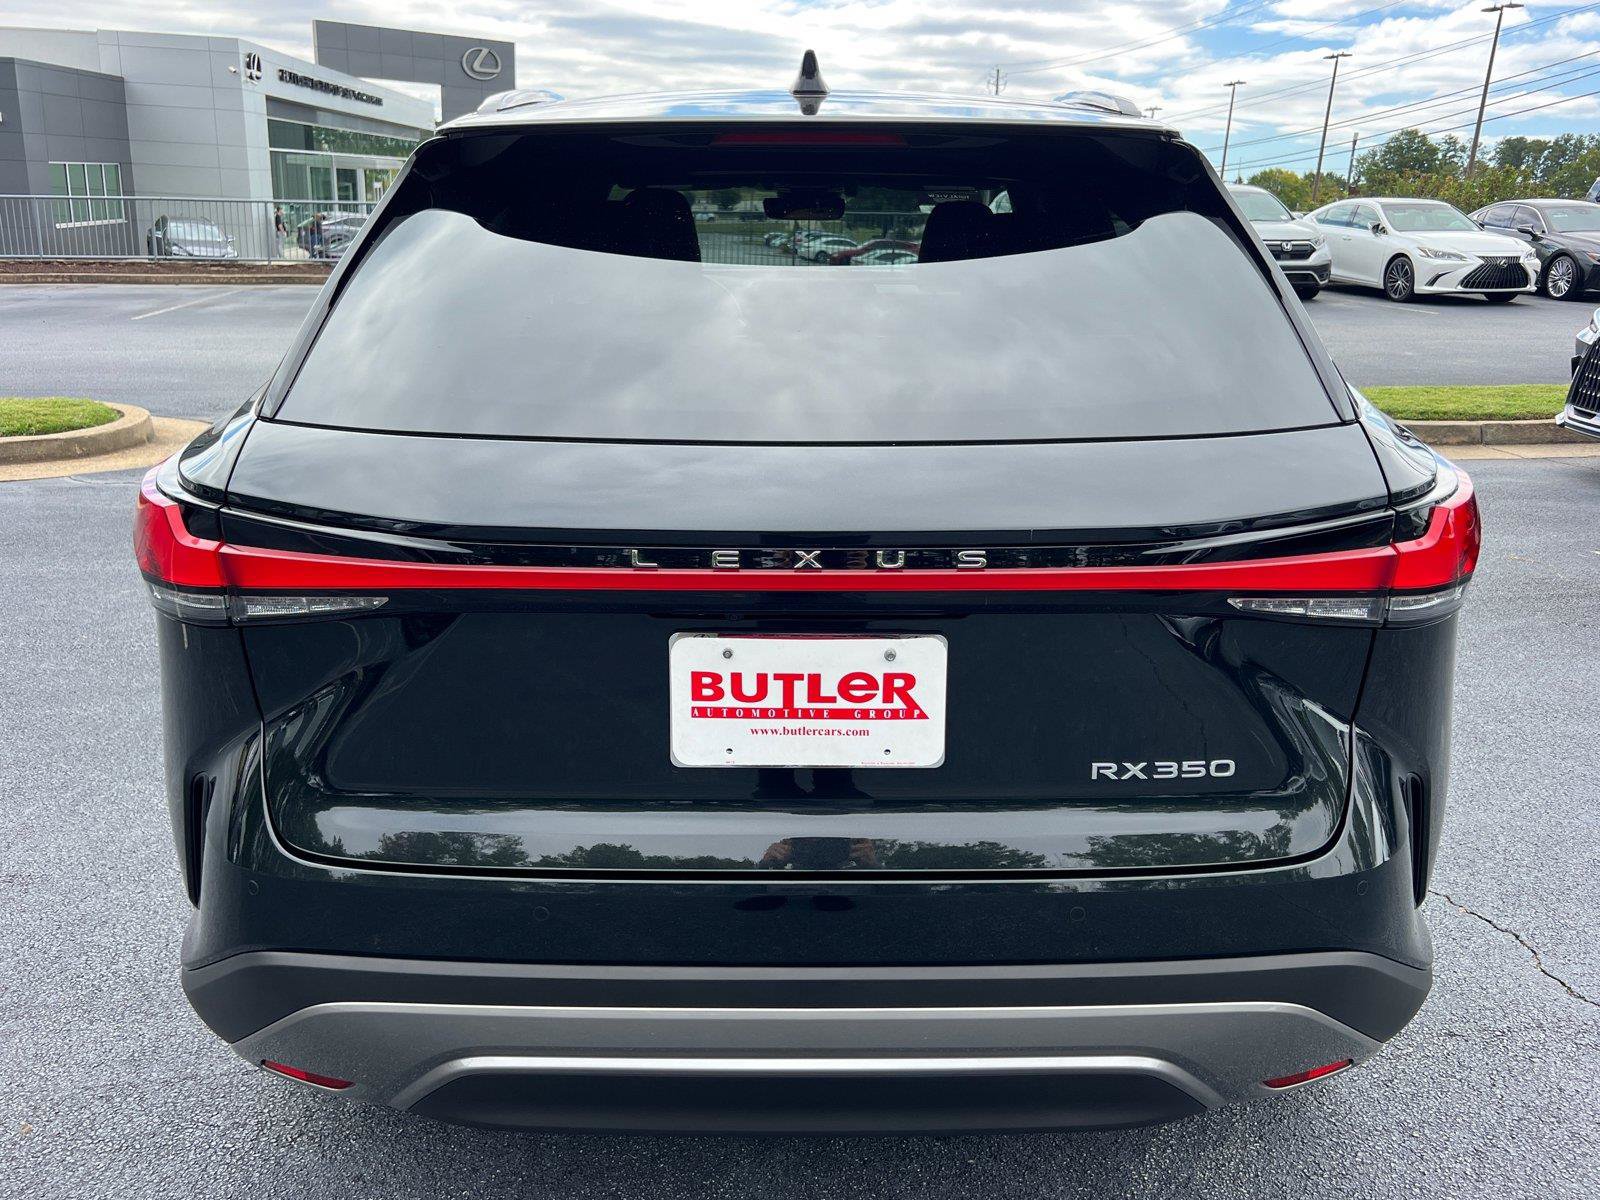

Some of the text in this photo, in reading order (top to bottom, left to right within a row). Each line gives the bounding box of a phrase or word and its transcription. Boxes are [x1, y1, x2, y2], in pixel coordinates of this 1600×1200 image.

[631, 549, 987, 568] LEXUS
[692, 707, 921, 719] AUTOMOTIVE GROUP
[750, 726, 870, 737] www.butlercars.com
